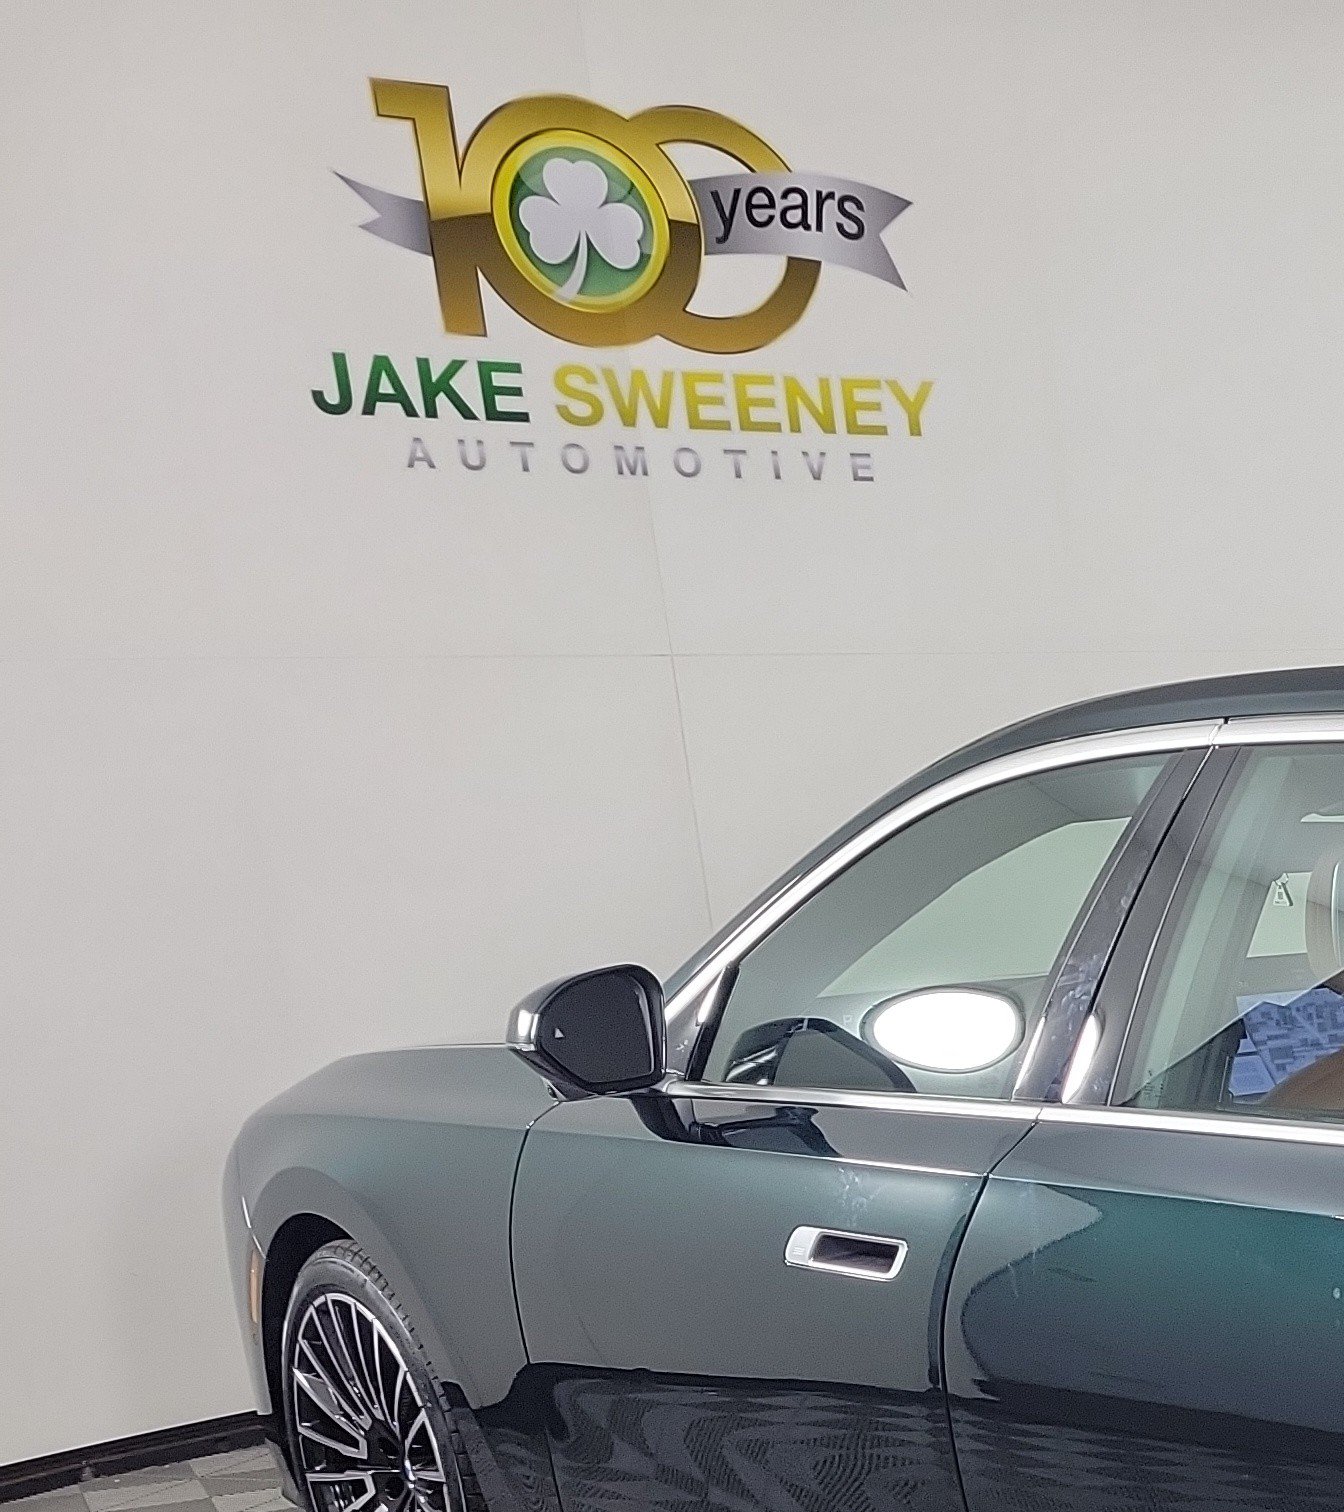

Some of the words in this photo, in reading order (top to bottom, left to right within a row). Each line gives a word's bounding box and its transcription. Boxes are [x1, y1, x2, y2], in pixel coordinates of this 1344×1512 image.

[709, 185, 866, 244] years
[311, 351, 531, 424] JAKE
[552, 363, 935, 438] SWEENEY
[406, 436, 875, 483] AUTOMOTIVE
